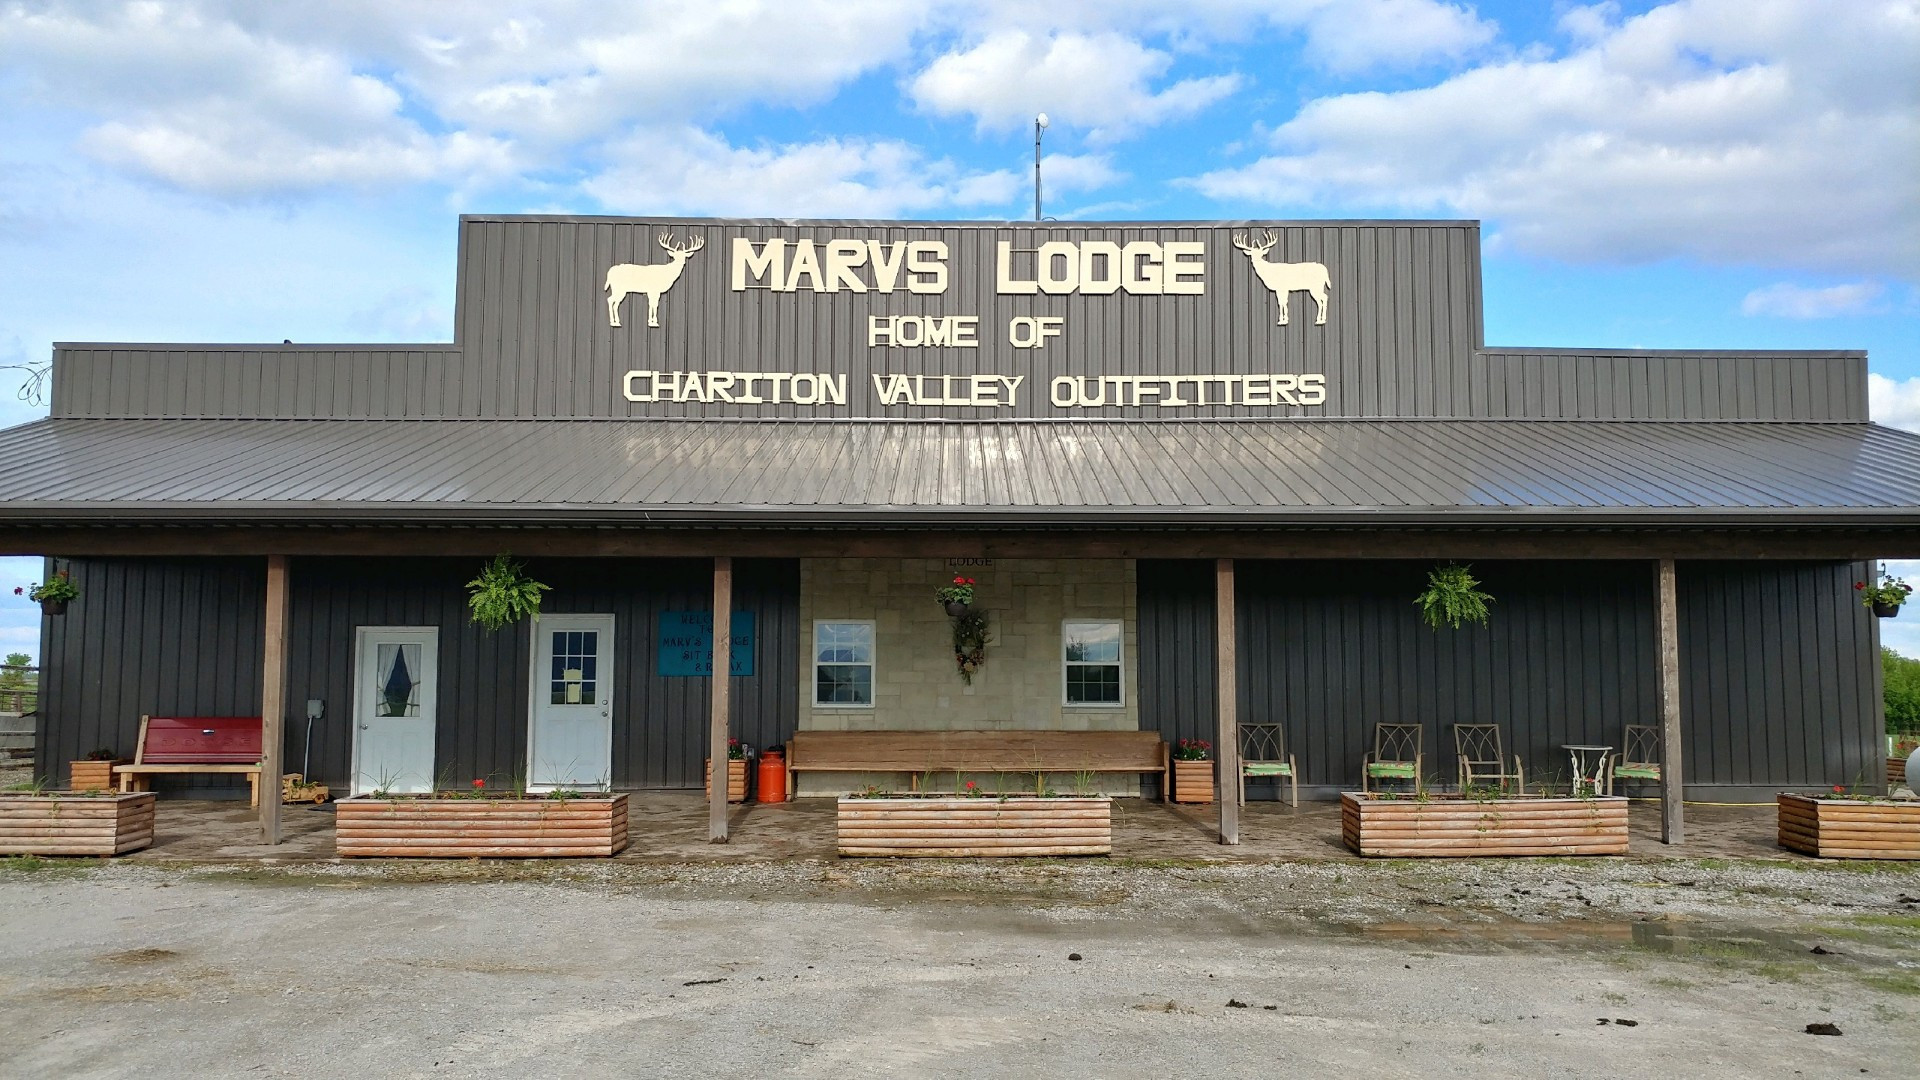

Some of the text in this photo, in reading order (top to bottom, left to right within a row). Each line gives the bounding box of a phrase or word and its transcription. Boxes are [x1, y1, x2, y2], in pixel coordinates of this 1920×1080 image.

[732, 238, 1205, 295] MARVS LODGE
[868, 315, 1064, 348] HOME OF
[623, 371, 1326, 407] CHARITON VALLEY OUTFITTERS
[949, 557, 992, 566] LODGE
[663, 636, 702, 647] MARV'S
[683, 650, 736, 660] SIT BK
